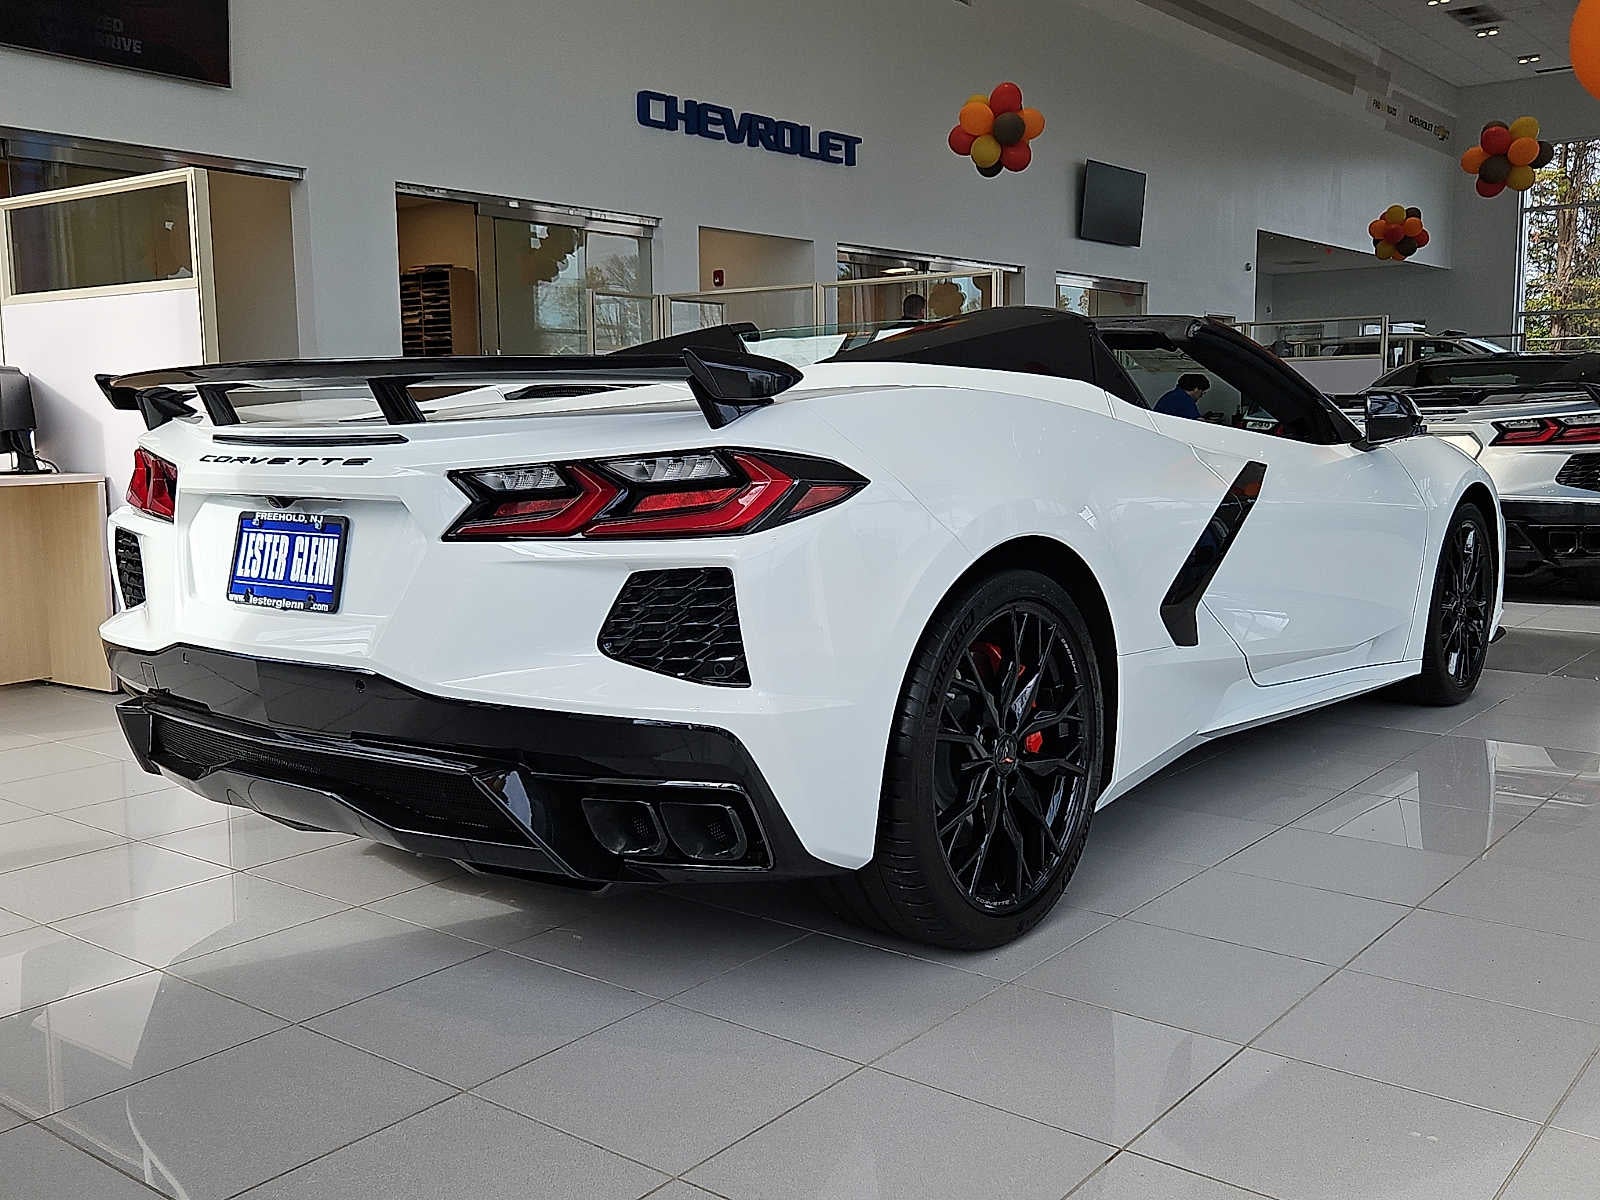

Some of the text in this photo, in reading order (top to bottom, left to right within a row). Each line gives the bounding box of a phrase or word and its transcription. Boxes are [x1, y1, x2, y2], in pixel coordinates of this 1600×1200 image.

[636, 90, 863, 167] CHEVROLET
[199, 454, 372, 466] CORVETTE
[255, 512, 324, 525] FREEHOLD, NJ
[236, 532, 339, 586] LESTER GLENN
